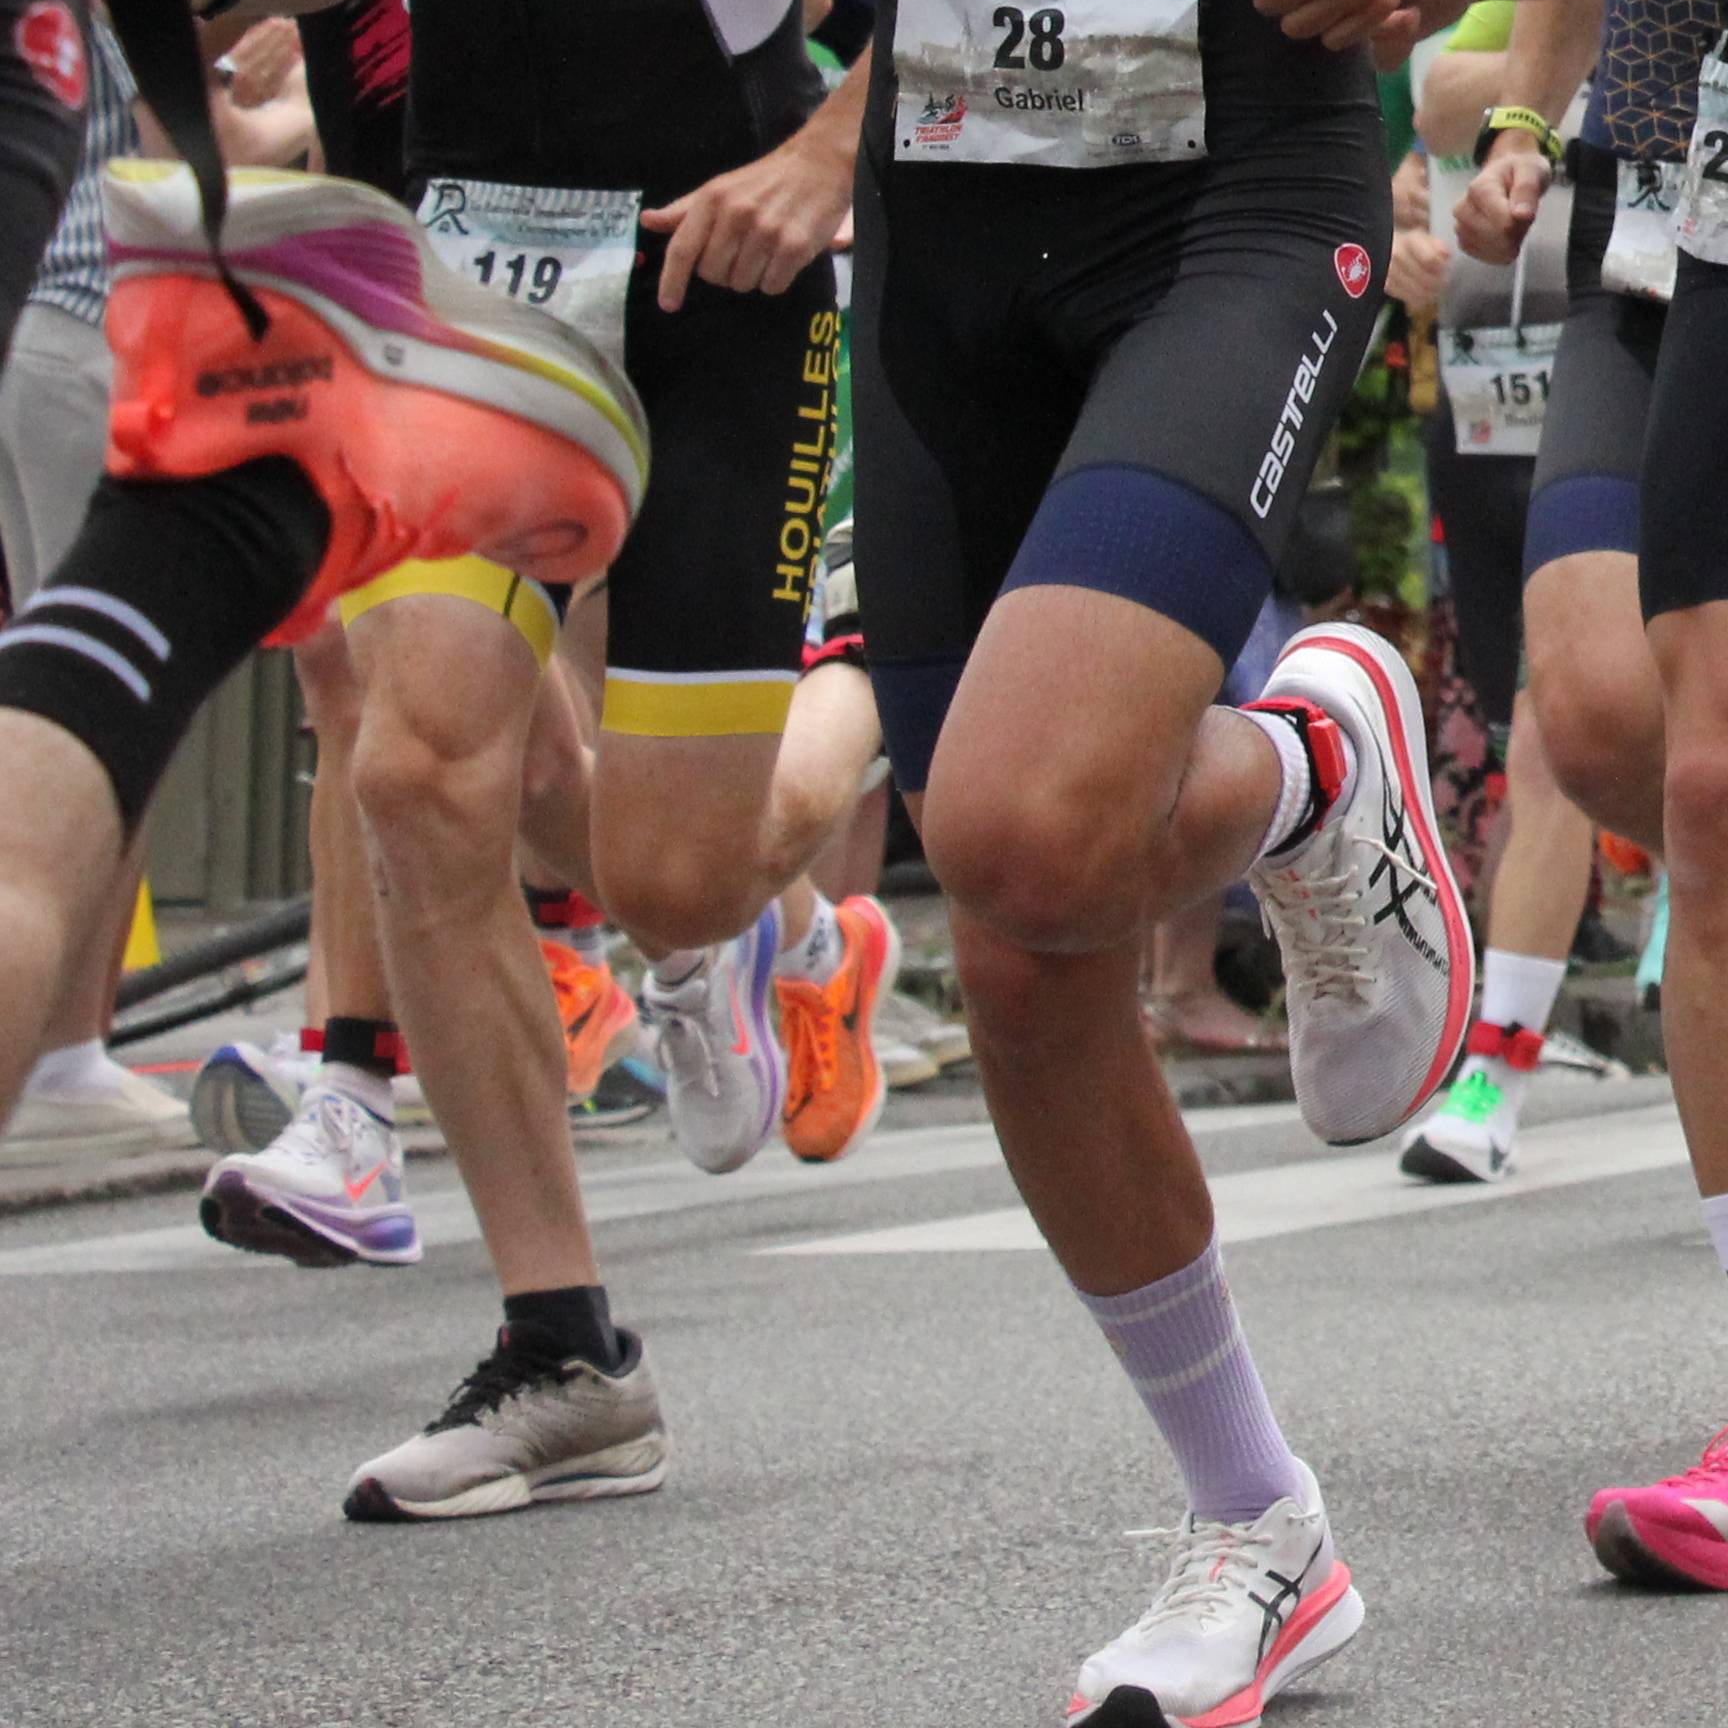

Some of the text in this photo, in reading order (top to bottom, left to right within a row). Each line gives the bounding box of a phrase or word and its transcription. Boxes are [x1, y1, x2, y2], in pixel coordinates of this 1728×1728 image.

[993, 6, 1065, 72] 28
[994, 86, 1085, 113] Gabriel
[474, 251, 562, 304] 119
[772, 308, 835, 603] HOUILLES
